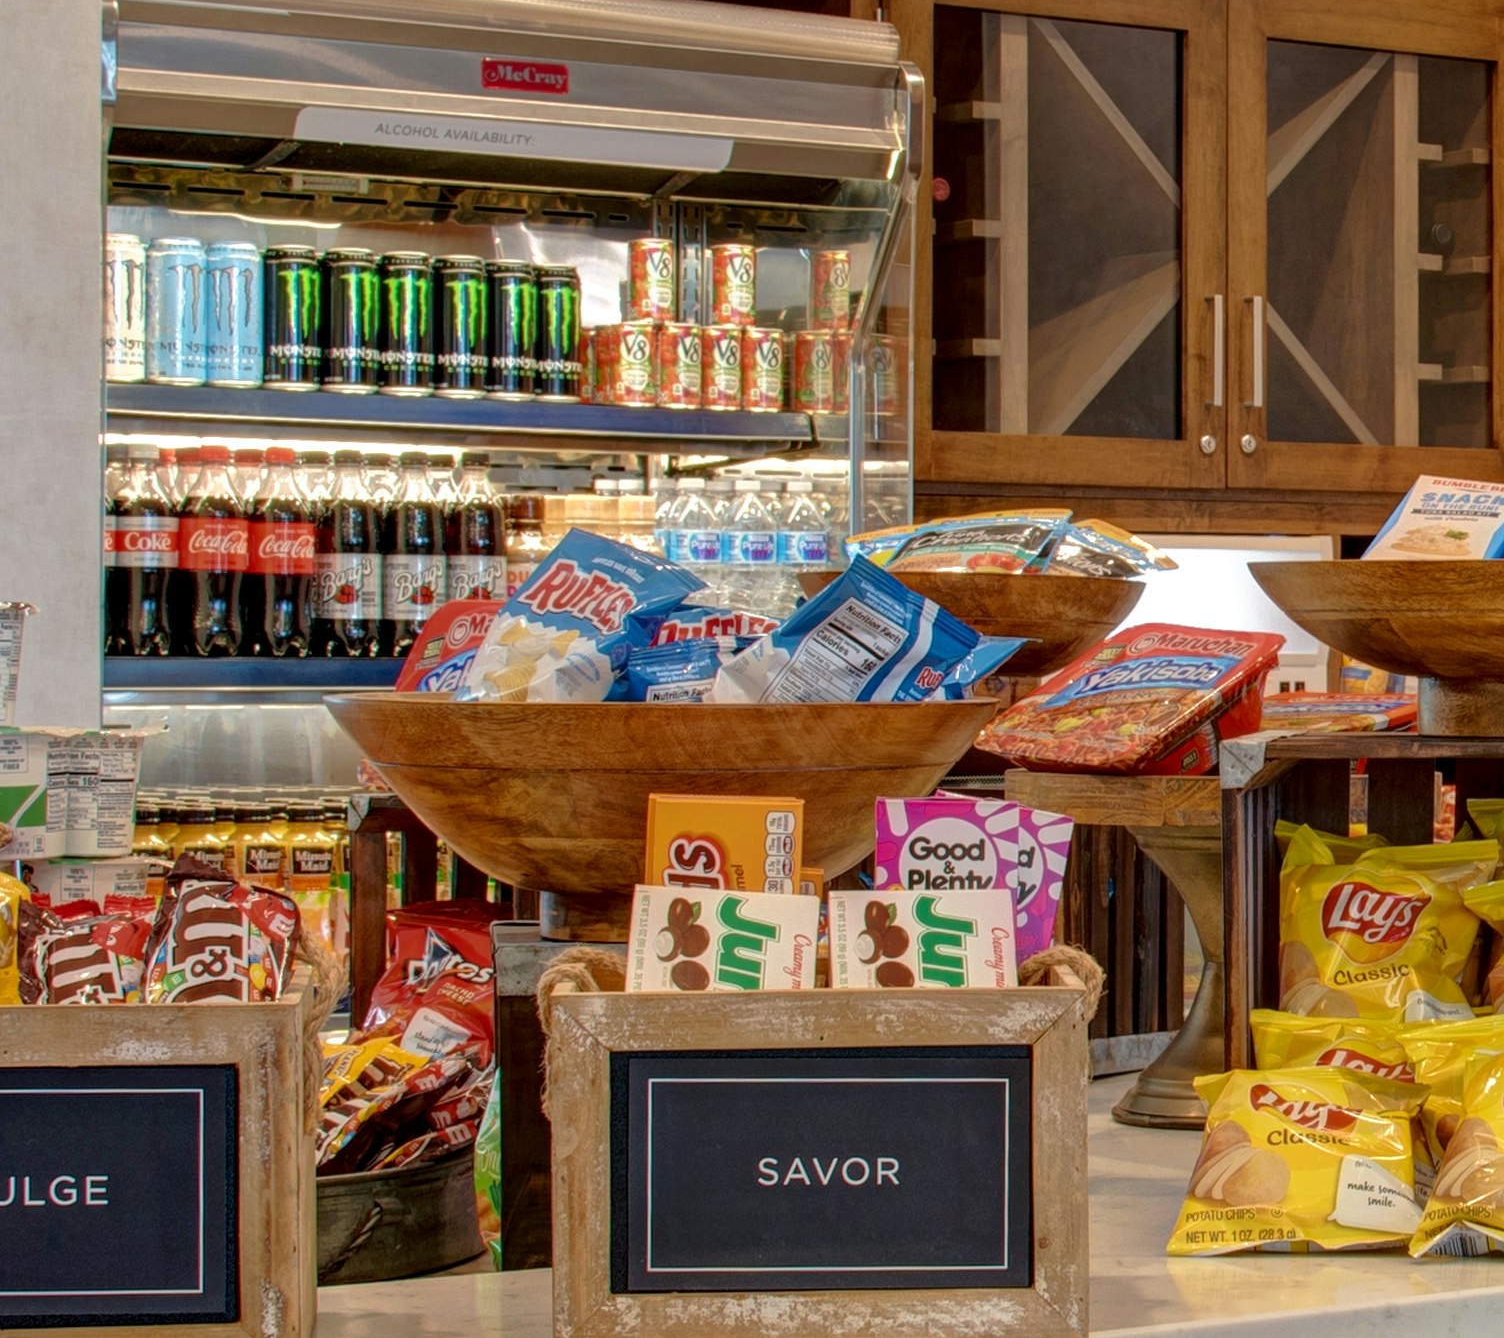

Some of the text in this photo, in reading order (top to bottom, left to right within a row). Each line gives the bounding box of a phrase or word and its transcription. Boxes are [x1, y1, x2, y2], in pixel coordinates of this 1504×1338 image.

[485, 65, 566, 88] McCray
[375, 123, 535, 146] ALCOHOL AVAILABILITY:
[648, 249, 670, 280] V8
[731, 254, 753, 284] V8
[622, 332, 647, 361] V8
[715, 338, 738, 366] V8
[758, 339, 780, 369] V8
[1433, 479, 1484, 491] BUMBLE
[125, 531, 171, 551] Coke
[321, 559, 373, 603] Barq's
[395, 561, 443, 603] Barq's
[518, 559, 636, 633] RUFFLES
[846, 605, 903, 644] Nutrition Facts
[815, 629, 849, 656] Calories
[1159, 632, 1255, 657] Maruchan
[1081, 660, 1222, 692] Yakisoba
[653, 689, 691, 701] Nutrition
[909, 836, 985, 861] Good
[908, 869, 993, 890] Plenty
[944, 861, 956, 874] &
[1328, 881, 1424, 943] Lay's
[1334, 963, 1410, 986] Classic
[1267, 1130, 1352, 1146] Classic
[757, 1157, 901, 1186] SAVOR
[1347, 1182, 1376, 1193] make
[1368, 1196, 1396, 1207] smile.
[1186, 1207, 1255, 1222] POTATO CHIPS
[1186, 1231, 1208, 1243] NET
[1210, 1231, 1229, 1243] WT.
